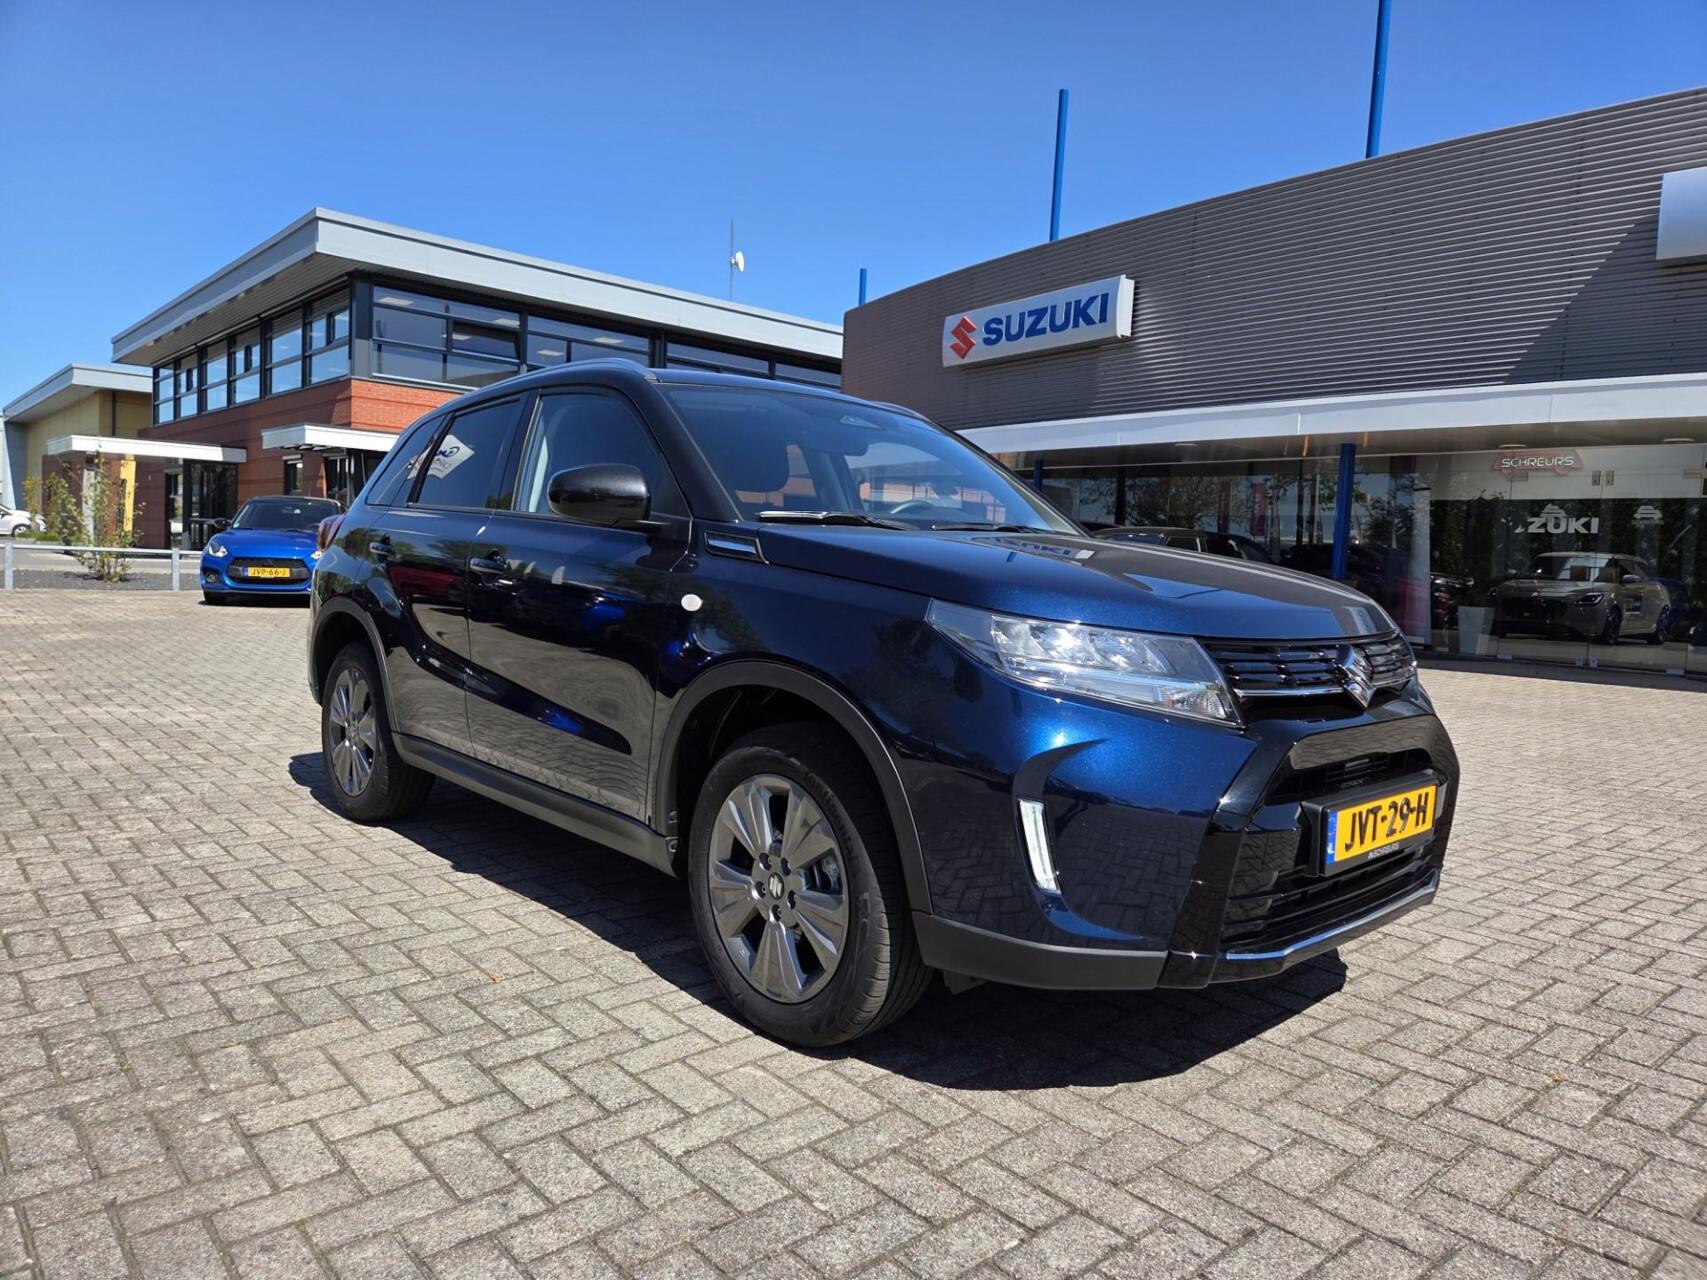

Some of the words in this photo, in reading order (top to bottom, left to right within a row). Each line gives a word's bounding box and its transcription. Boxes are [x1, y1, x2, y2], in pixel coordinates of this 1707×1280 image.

[982, 293, 1109, 346] SUZUKI
[1501, 456, 1574, 468] SCHREURS
[1514, 517, 1600, 534] ZUKI
[1345, 792, 1429, 851] JVT-29-H
